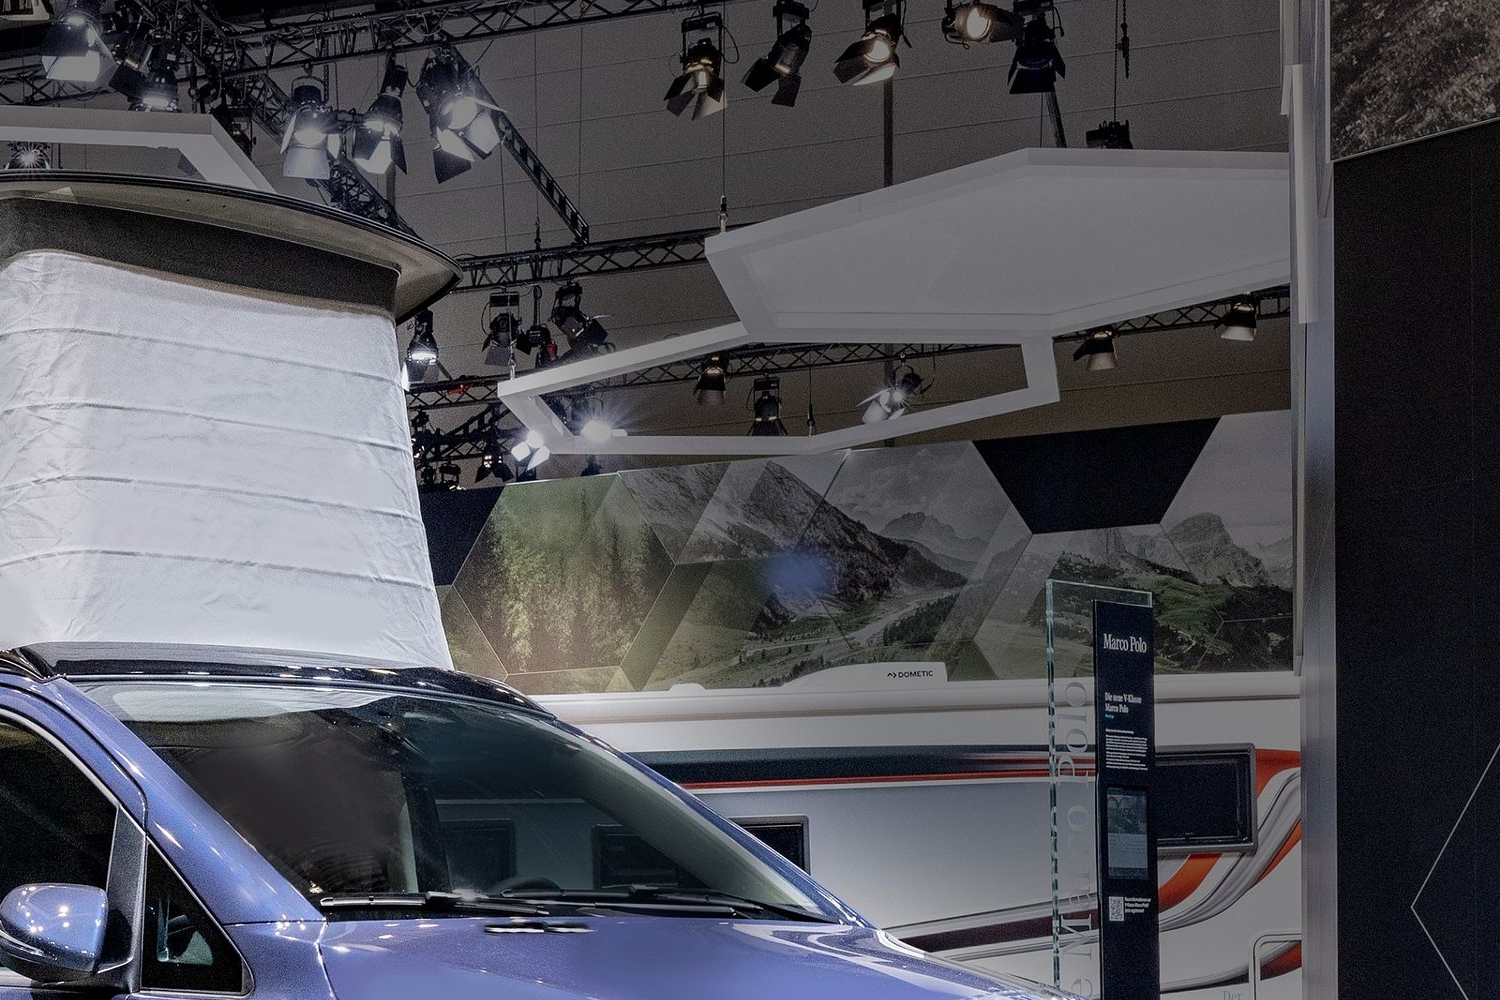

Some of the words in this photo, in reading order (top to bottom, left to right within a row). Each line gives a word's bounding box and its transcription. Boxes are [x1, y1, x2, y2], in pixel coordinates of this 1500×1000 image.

[1103, 633, 1129, 651] Marco
[1129, 635, 1147, 653] Polo
[898, 670, 934, 678] DOMETIC
